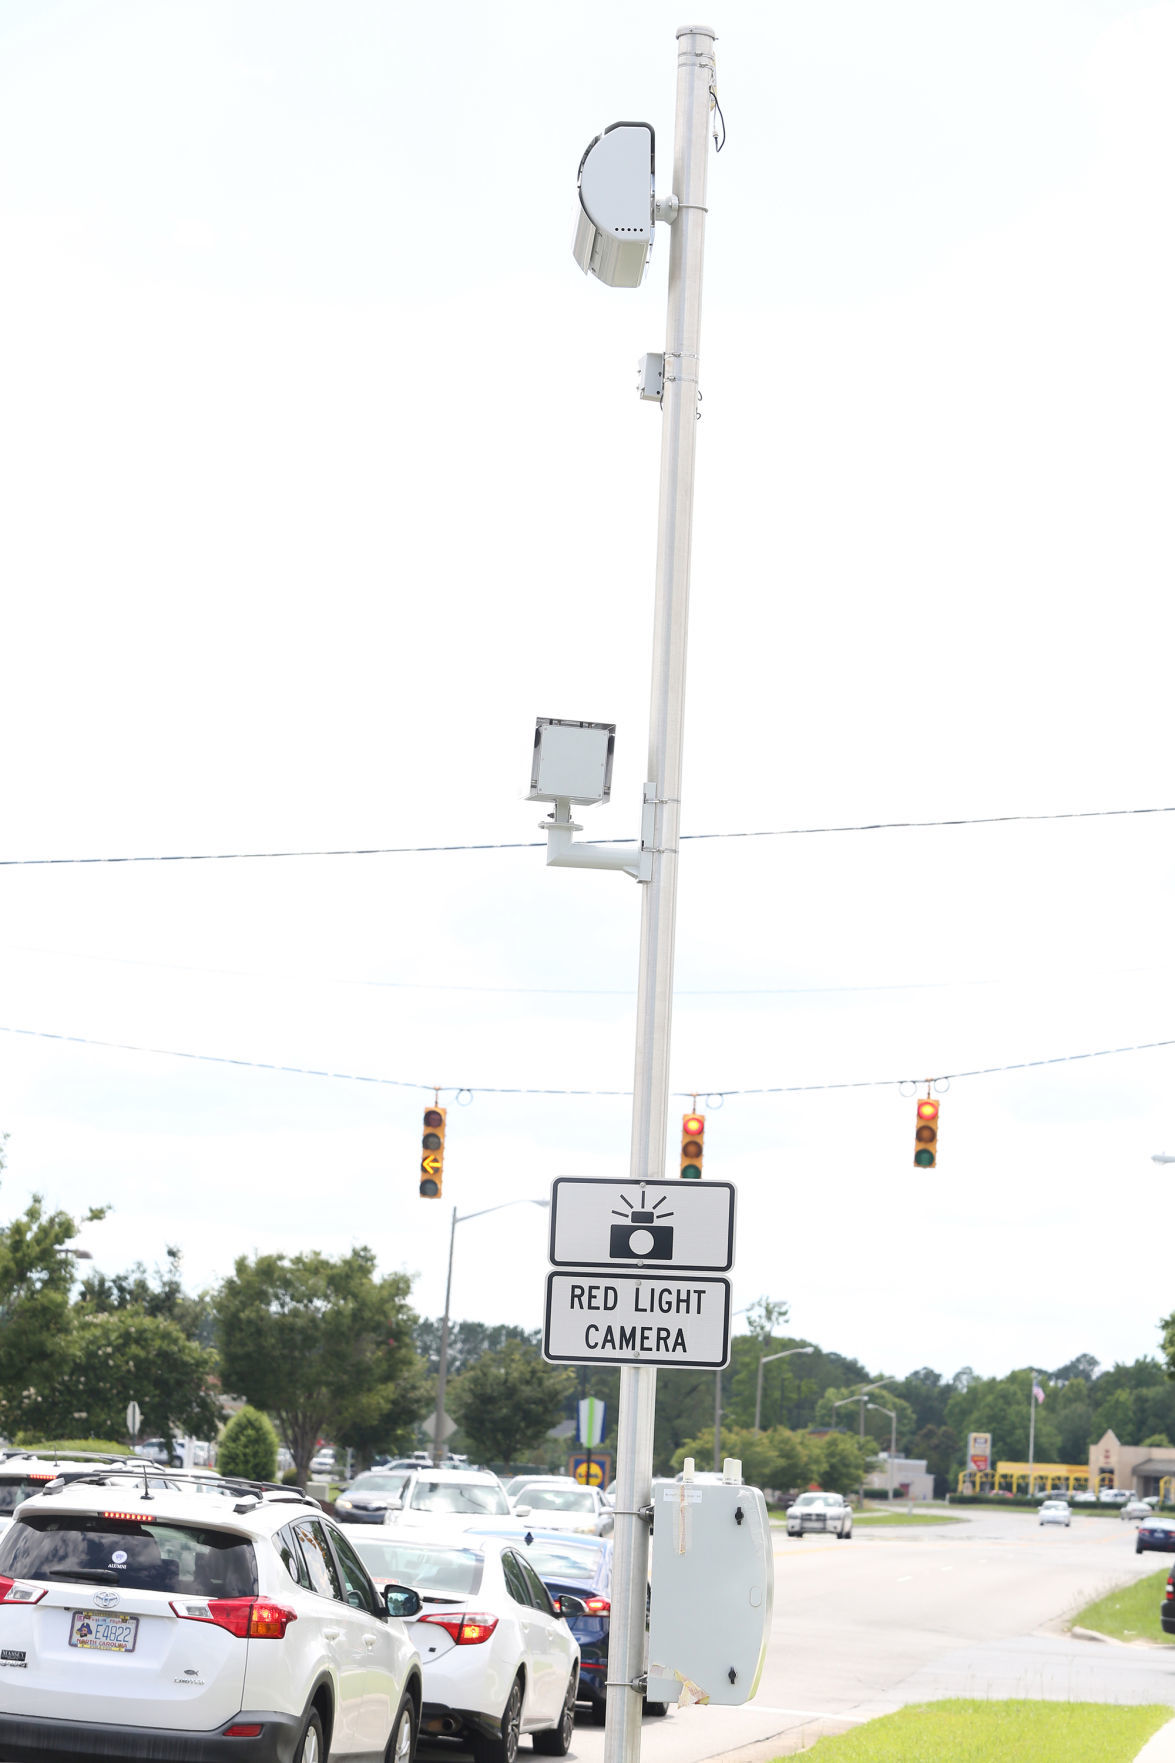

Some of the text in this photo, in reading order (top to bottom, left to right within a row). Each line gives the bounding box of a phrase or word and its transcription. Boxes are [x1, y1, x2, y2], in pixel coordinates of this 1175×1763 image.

[570, 1284, 707, 1315] RED LIGHT
[584, 1323, 688, 1353] CAMERA
[95, 1624, 131, 1642] E4822
